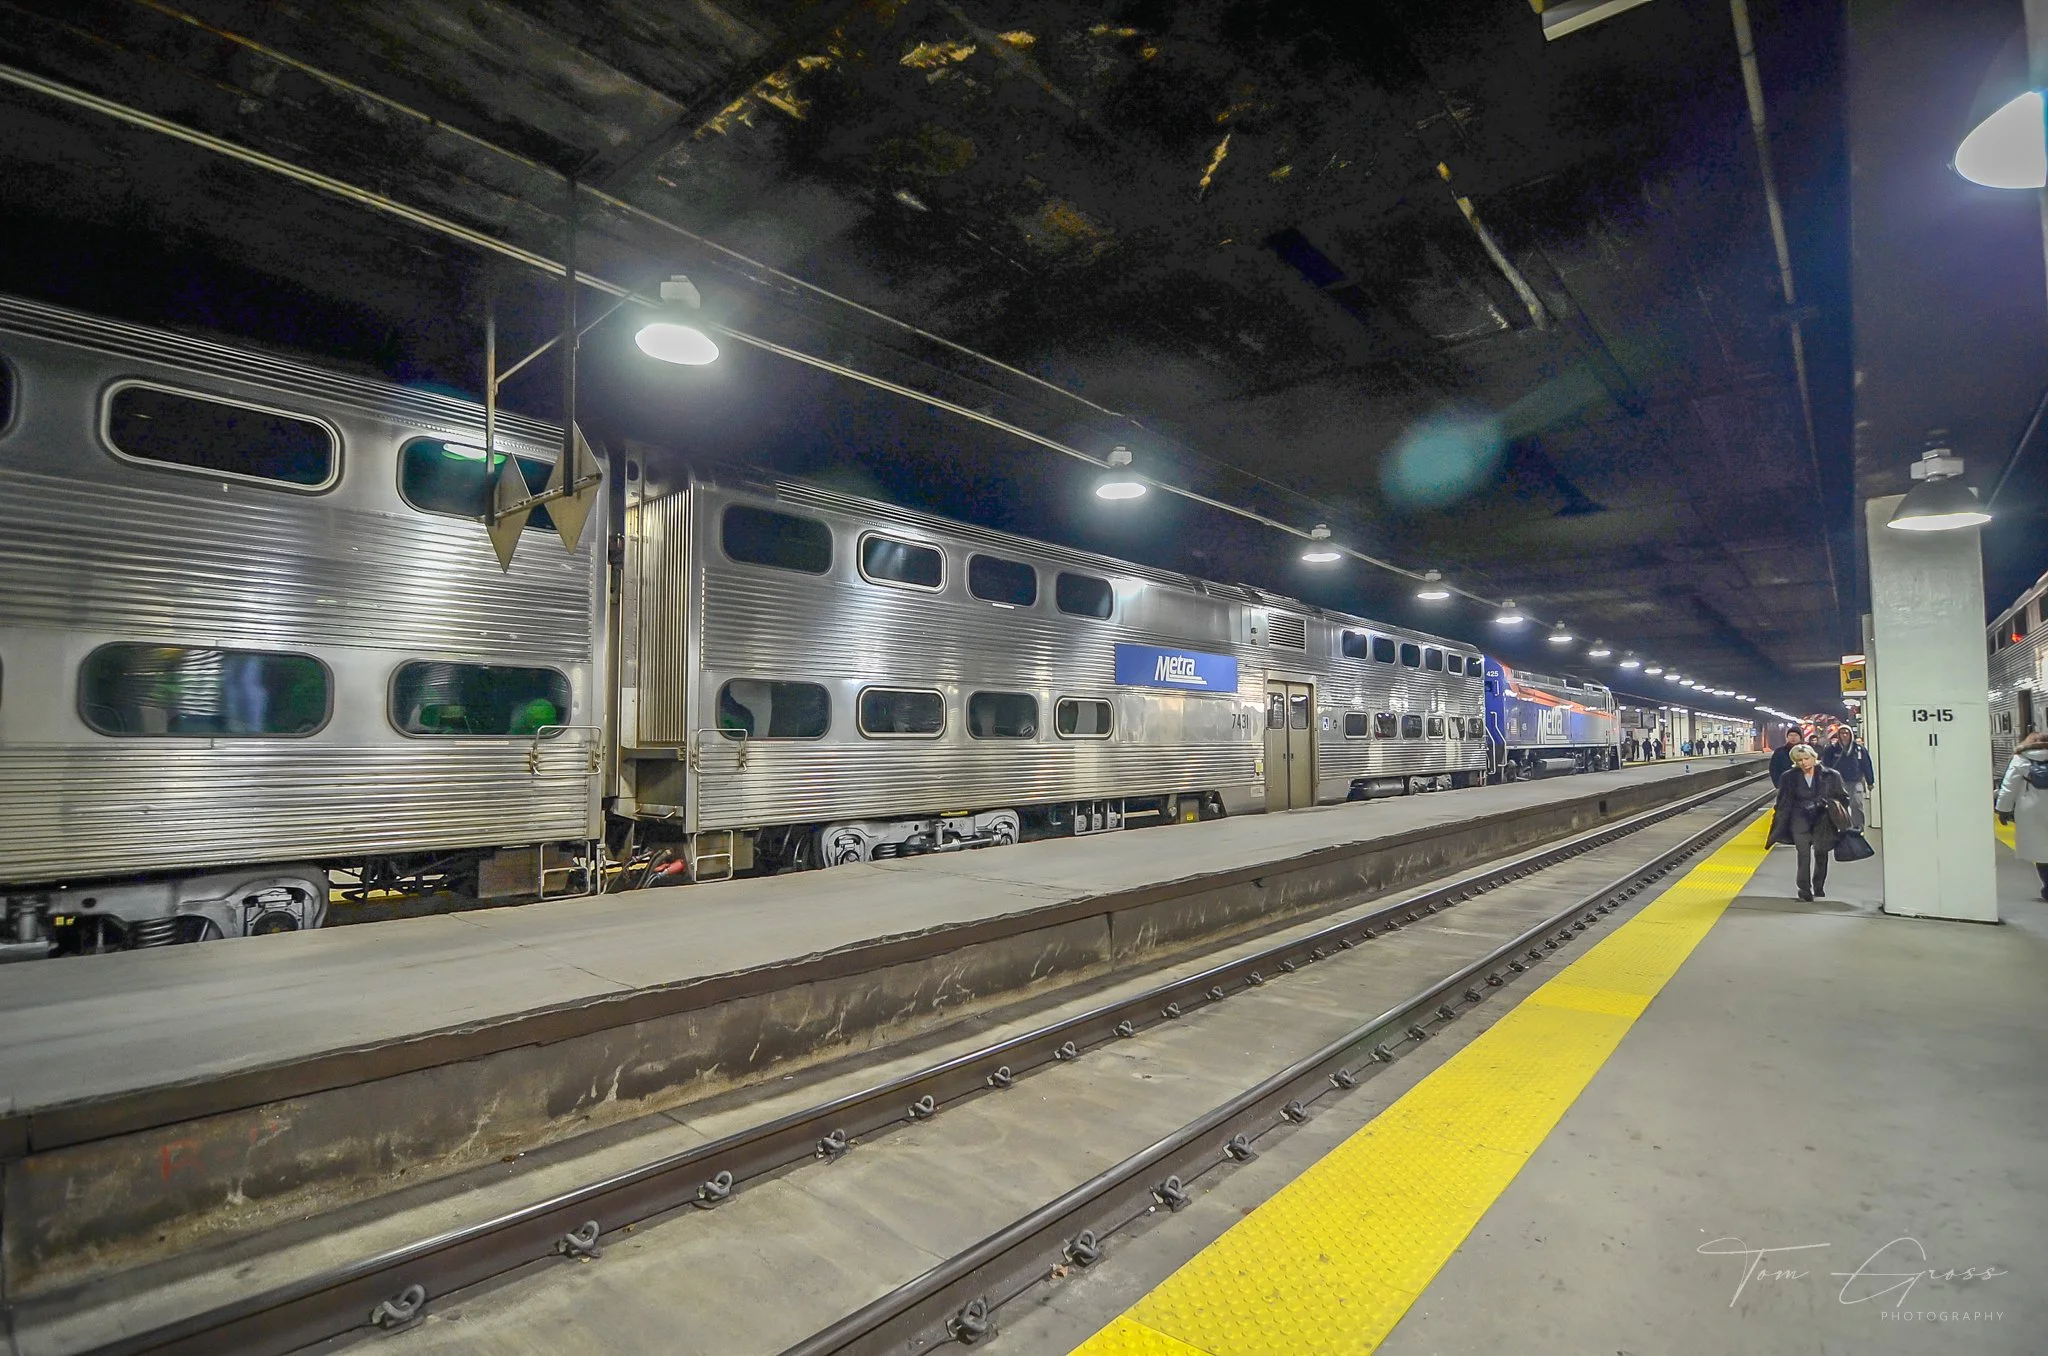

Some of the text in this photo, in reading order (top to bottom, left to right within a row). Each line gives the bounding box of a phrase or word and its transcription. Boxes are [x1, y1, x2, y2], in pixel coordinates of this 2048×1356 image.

[1154, 655, 1201, 682] Metra
[1231, 714, 1249, 729] 7431
[1537, 705, 1565, 744] Metra
[1912, 709, 1953, 722] 13-15
